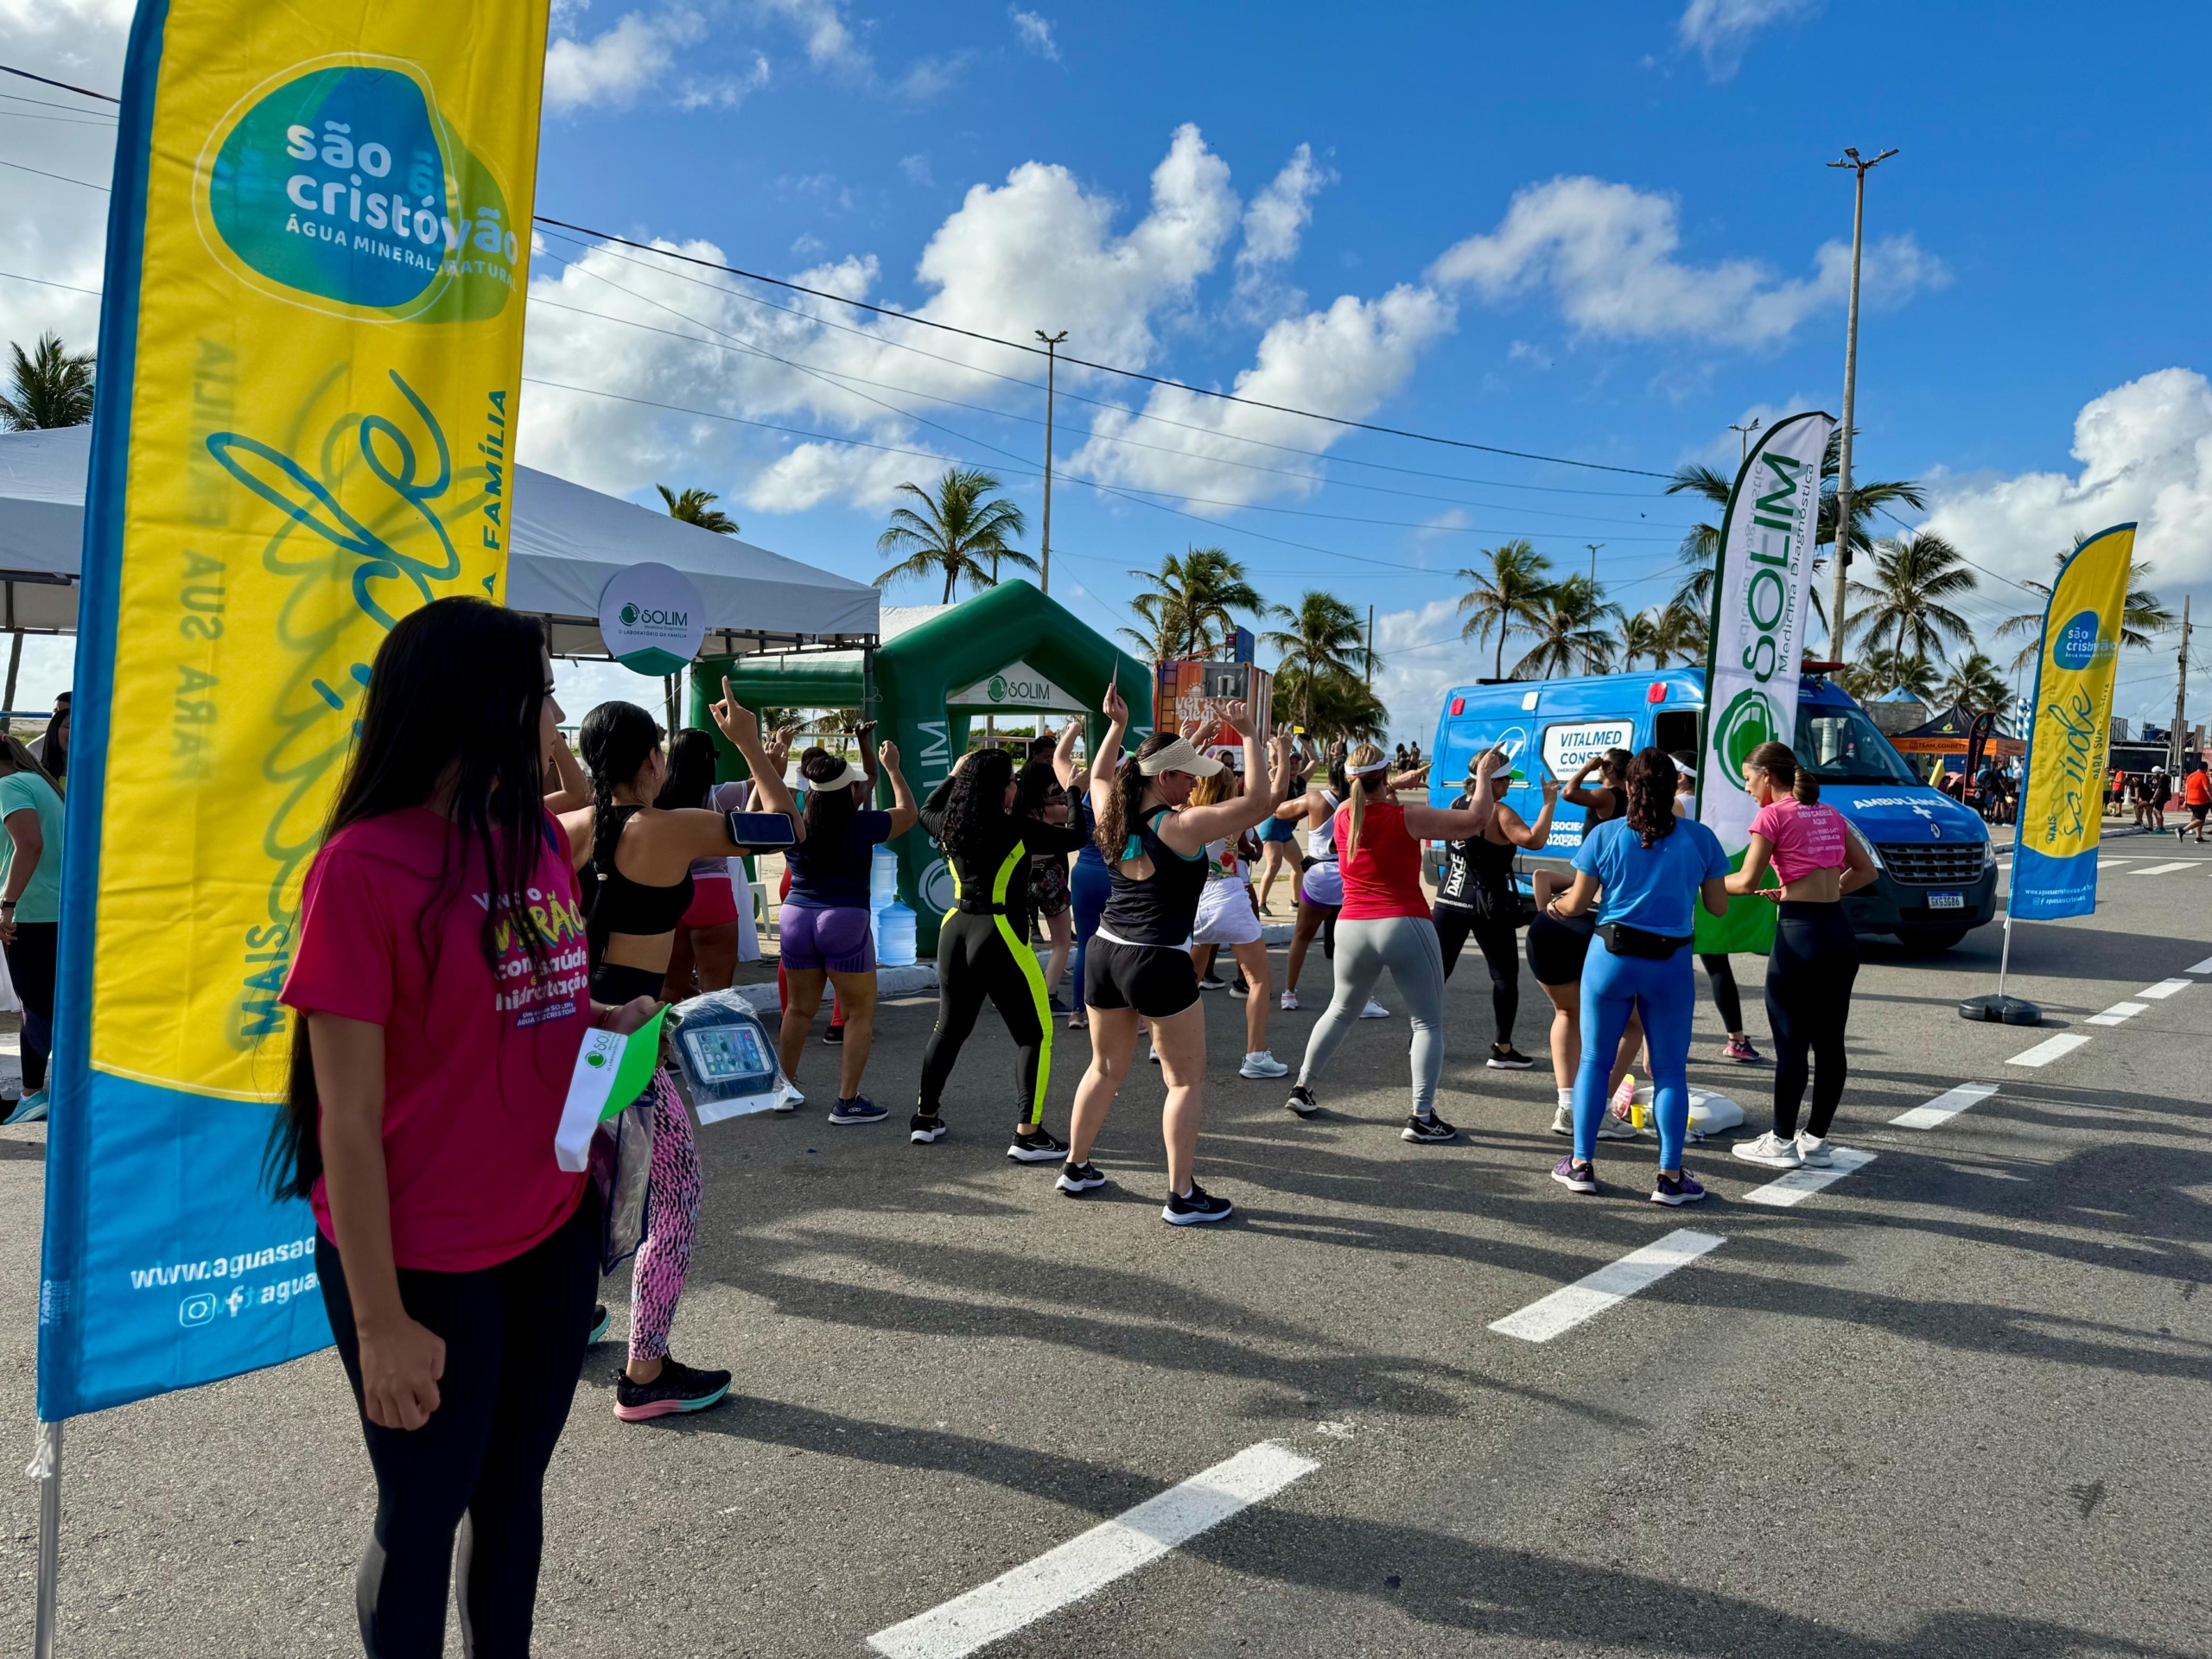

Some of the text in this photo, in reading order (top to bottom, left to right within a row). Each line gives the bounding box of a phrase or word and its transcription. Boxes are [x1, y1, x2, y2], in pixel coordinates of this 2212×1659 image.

[286, 120, 391, 178] são
[286, 174, 518, 265] cristóvão
[285, 213, 517, 292] ÁGUA MINERAL NATURAL
[477, 391, 506, 551] FAMÍLIA
[1742, 451, 1801, 683] SOLIM
[1778, 464, 1814, 672] Medicina Diagnóstica
[641, 609, 688, 626] SOLIM
[2068, 626, 2088, 639] são
[1008, 682, 1050, 700] SOLIM
[1560, 730, 1622, 747] VITALMED
[1446, 853, 1465, 897] DANCE
[240, 925, 290, 1037] MAIS
[261, 1272, 320, 1306] agua
